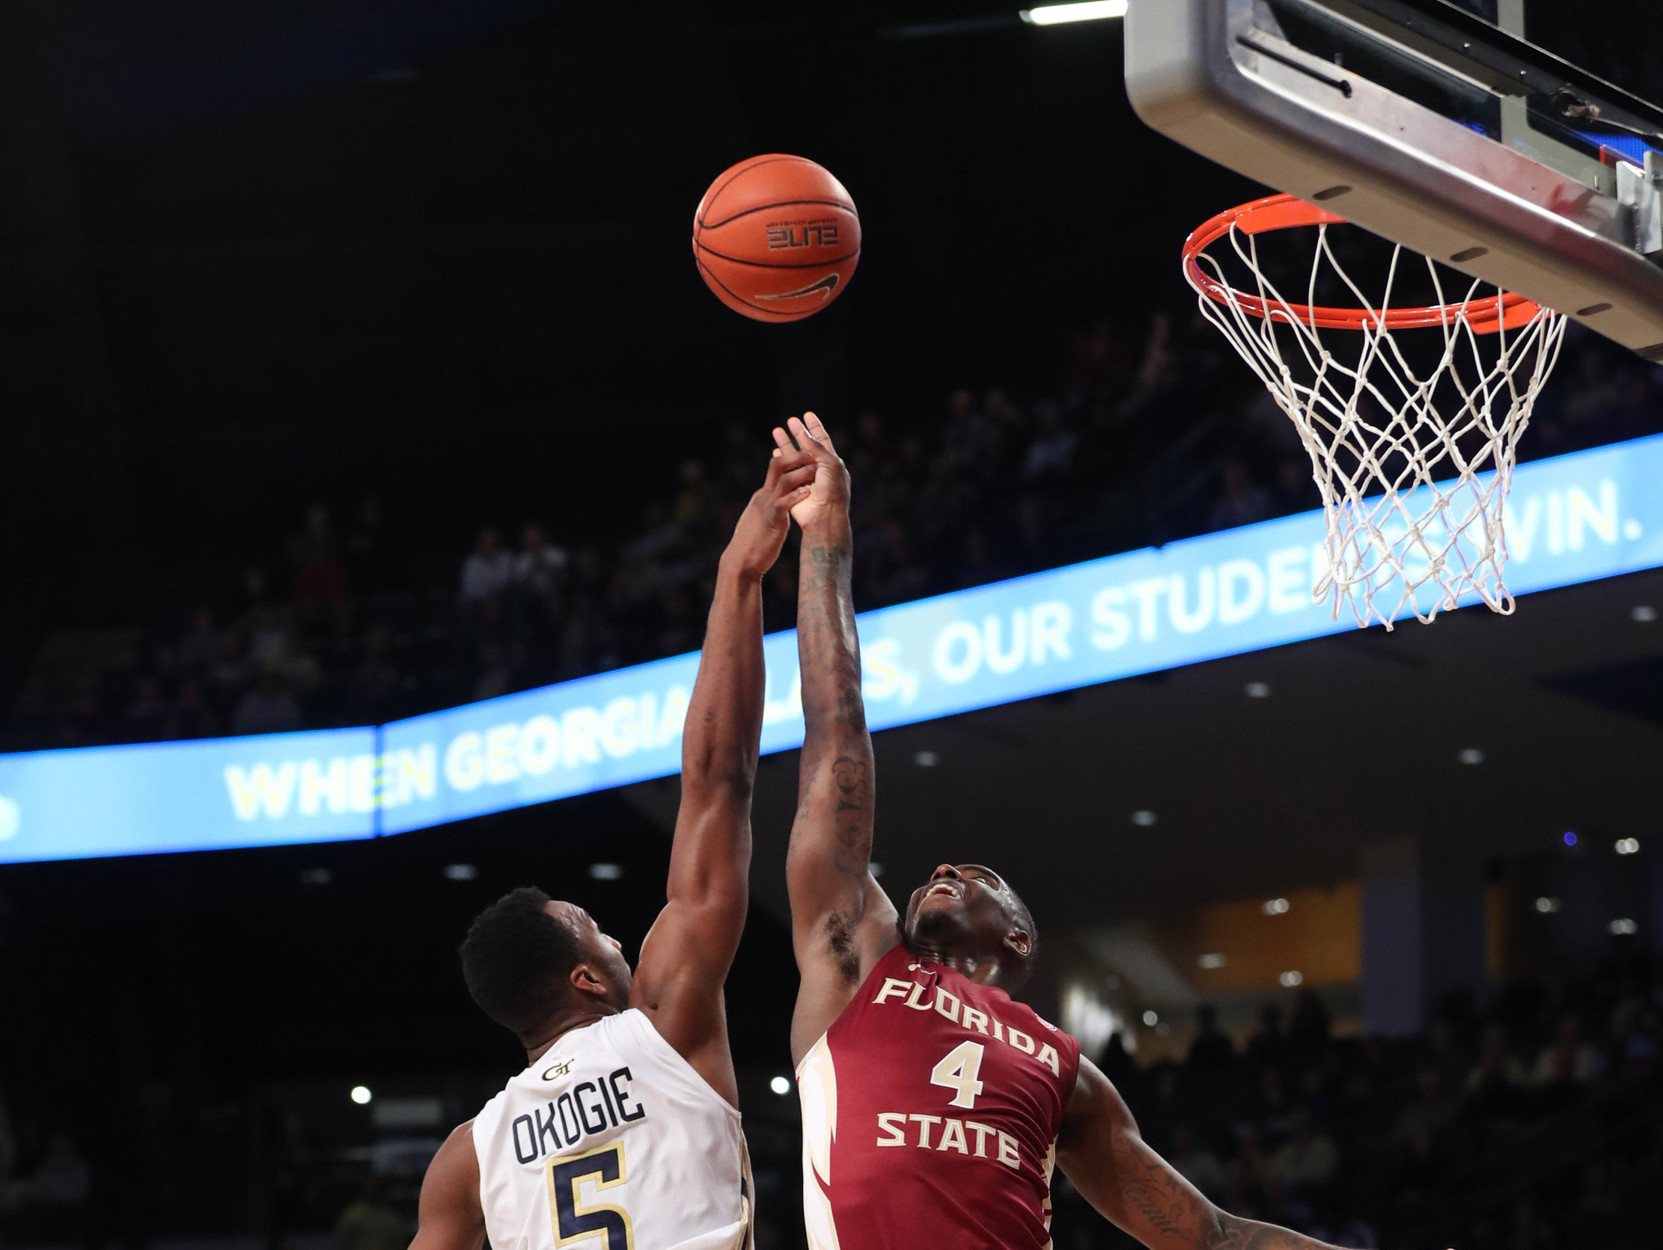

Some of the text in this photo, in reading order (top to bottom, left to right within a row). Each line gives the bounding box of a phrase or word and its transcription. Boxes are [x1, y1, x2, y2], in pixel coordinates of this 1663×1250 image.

[767, 224, 839, 251] ELITE
[224, 742, 437, 821] WHEN
[445, 685, 690, 791] GEORGIA
[933, 602, 1073, 684] OUR
[1472, 478, 1644, 570] WIN.
[872, 977, 1060, 1078] FLORIDA
[541, 1057, 576, 1082] GT
[930, 1040, 985, 1109] 4
[512, 1066, 646, 1165] OKOGIE
[876, 1112, 1021, 1171] STATE
